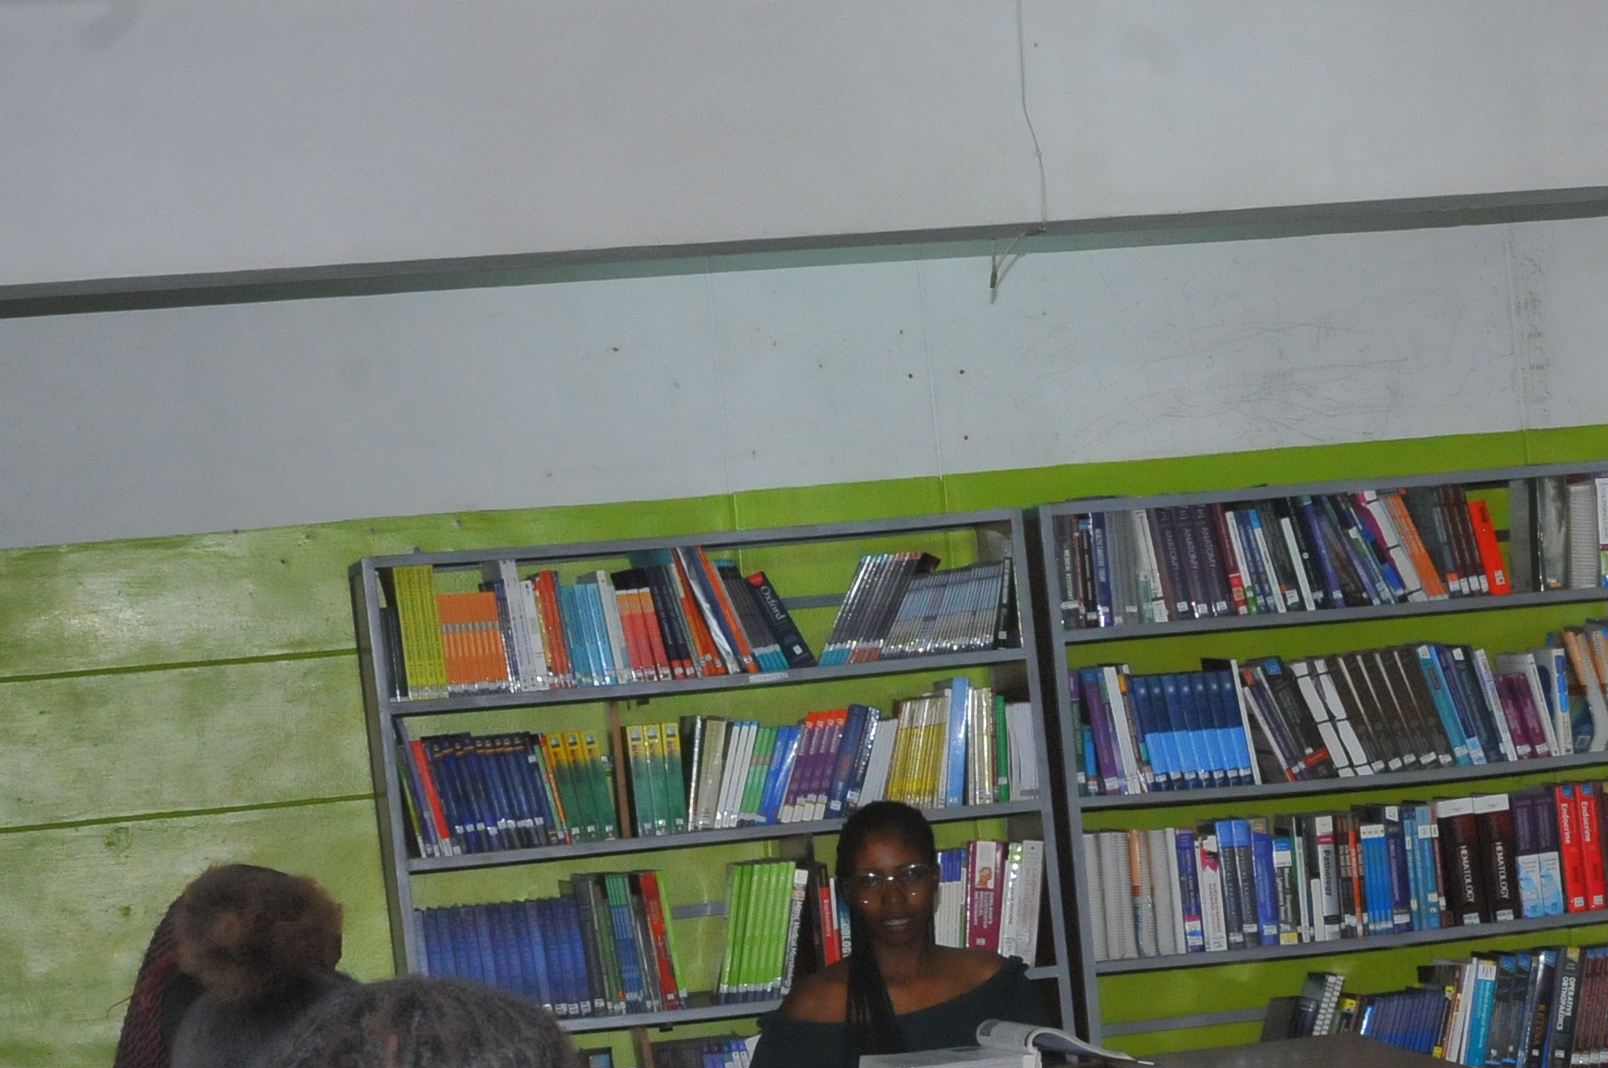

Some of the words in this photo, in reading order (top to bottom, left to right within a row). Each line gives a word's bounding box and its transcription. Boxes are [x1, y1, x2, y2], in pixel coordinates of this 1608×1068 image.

[1165, 529, 1179, 571] ANATOMY
[1184, 528, 1198, 570] ANATOMY
[1202, 526, 1216, 568] ANATOMY
[760, 585, 786, 621] Oxford
[1561, 803, 1572, 844] Endocrine
[1581, 801, 1592, 842] Endocrine
[1239, 847, 1247, 879] PHYSICAL
[1323, 850, 1333, 896] Pathology
[1459, 845, 1475, 903] HEMATOLOGY
[1495, 841, 1509, 899] HEMATOLOGY
[823, 899, 832, 937] Biochemistry
[1242, 882, 1251, 924] EXAMINATIO
[791, 921, 799, 946] Medical
[784, 948, 796, 988] Microbiology
[1555, 976, 1569, 1031] ORTHOPAEDICS
[1564, 977, 1576, 1017] OPERATIVE
[1533, 1005, 1546, 1045] RETINA
